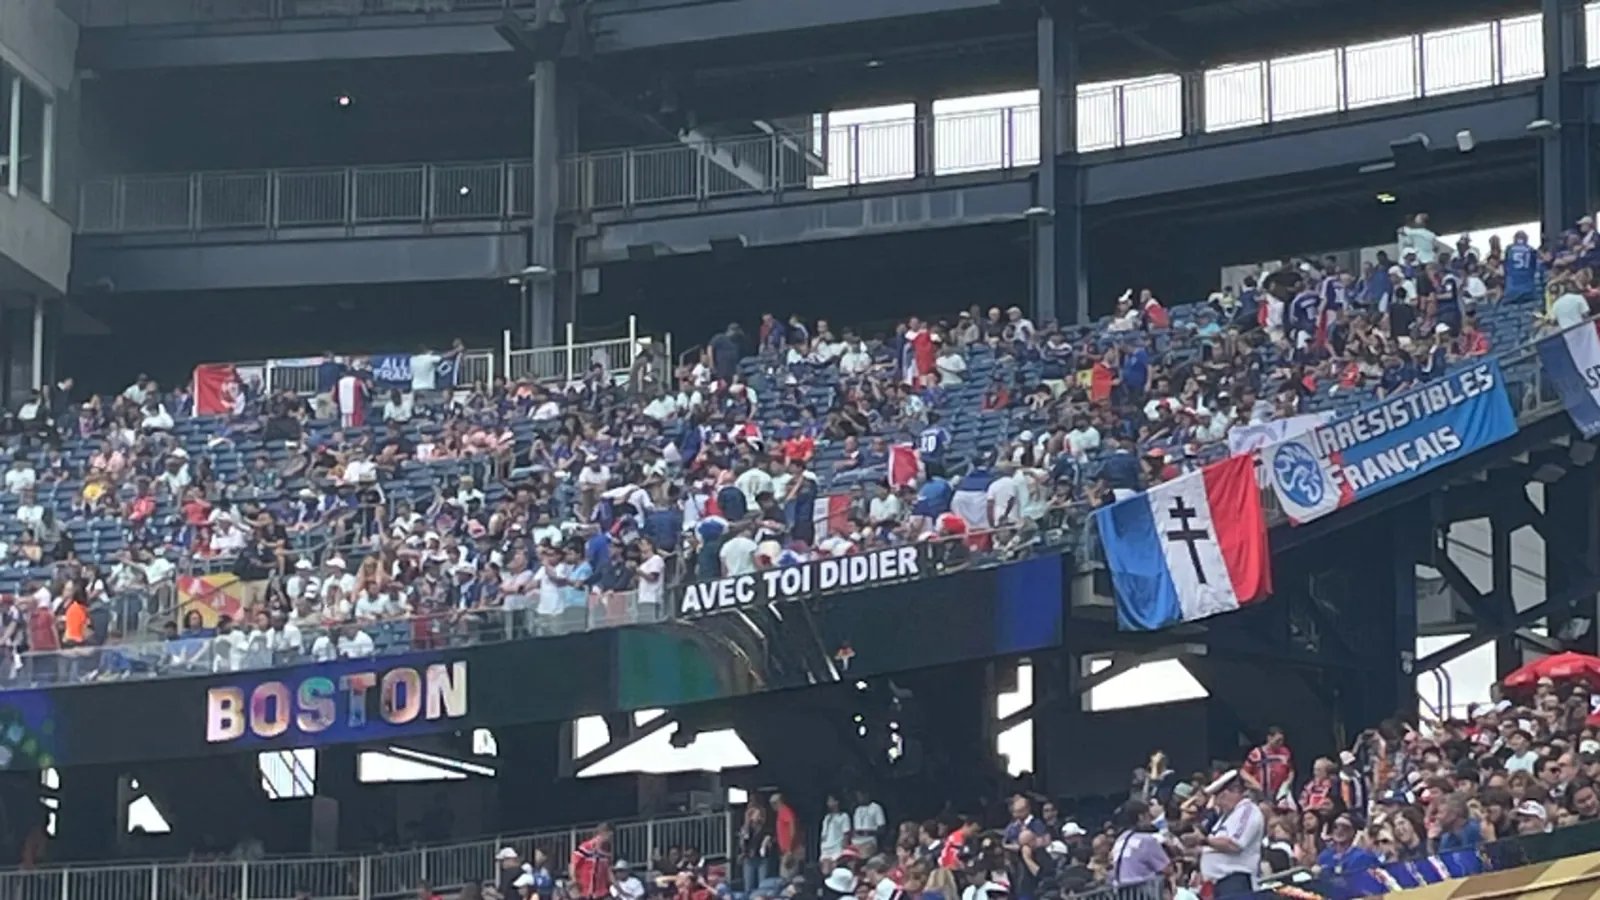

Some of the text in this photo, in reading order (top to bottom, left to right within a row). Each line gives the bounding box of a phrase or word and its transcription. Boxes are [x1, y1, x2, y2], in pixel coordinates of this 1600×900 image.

[1325, 426, 1461, 496] FRANÇAIS
[681, 547, 919, 612] AVEC TOI DIDIER
[207, 662, 468, 742] BOSTON
